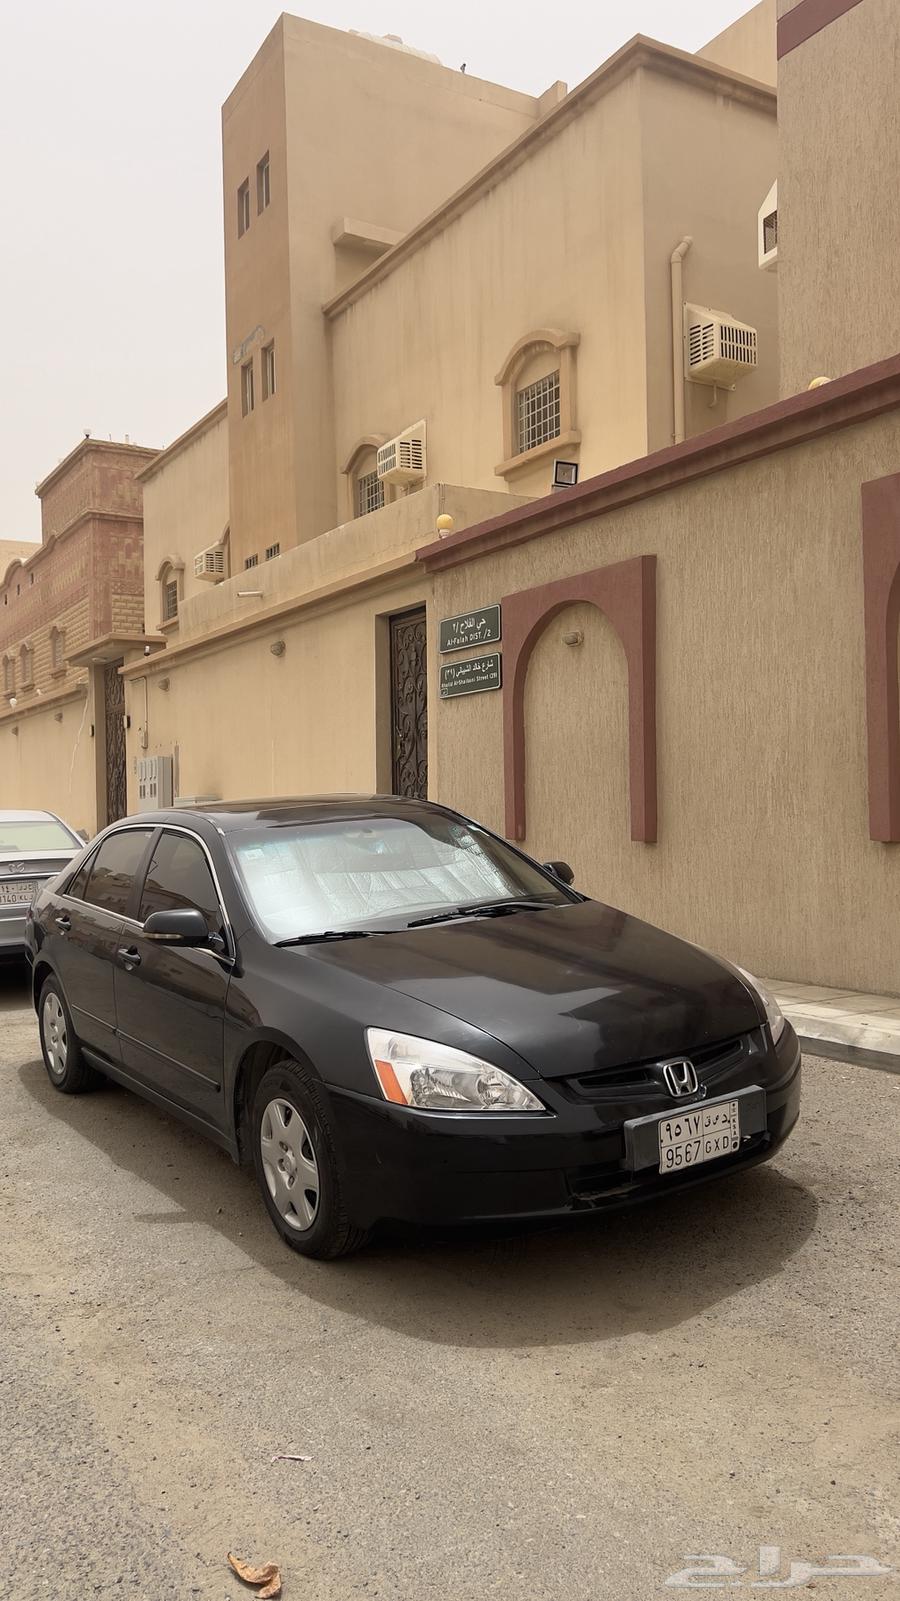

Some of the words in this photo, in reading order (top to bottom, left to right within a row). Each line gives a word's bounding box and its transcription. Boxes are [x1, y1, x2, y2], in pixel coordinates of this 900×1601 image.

[459, 617, 476, 634] الفلاح
[476, 618, 486, 630] حي
[447, 635, 469, 647] Al-Falah
[482, 659, 494, 673] شارع
[665, 1115, 700, 1141] ٩٥٦٧
[666, 1140, 701, 1169] 9567
[705, 1135, 729, 1154] GXD
